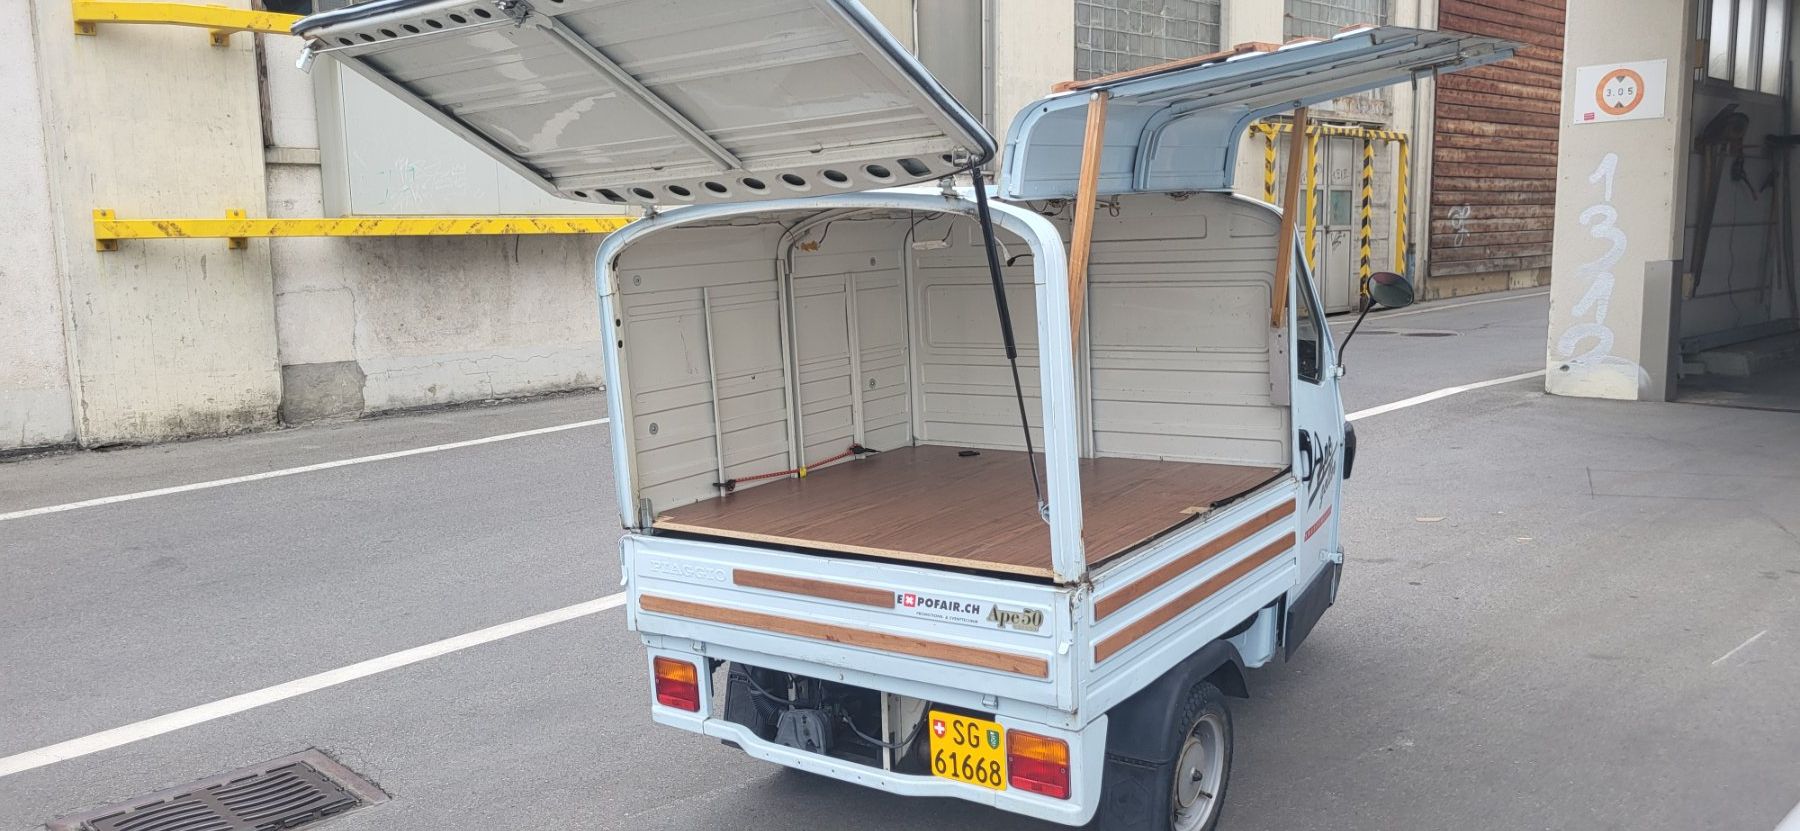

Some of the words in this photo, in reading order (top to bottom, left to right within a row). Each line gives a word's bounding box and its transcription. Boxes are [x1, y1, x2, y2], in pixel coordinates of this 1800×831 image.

[648, 559, 727, 582] PIAGGIO
[952, 719, 980, 748] SG
[934, 748, 1002, 787] 61668
